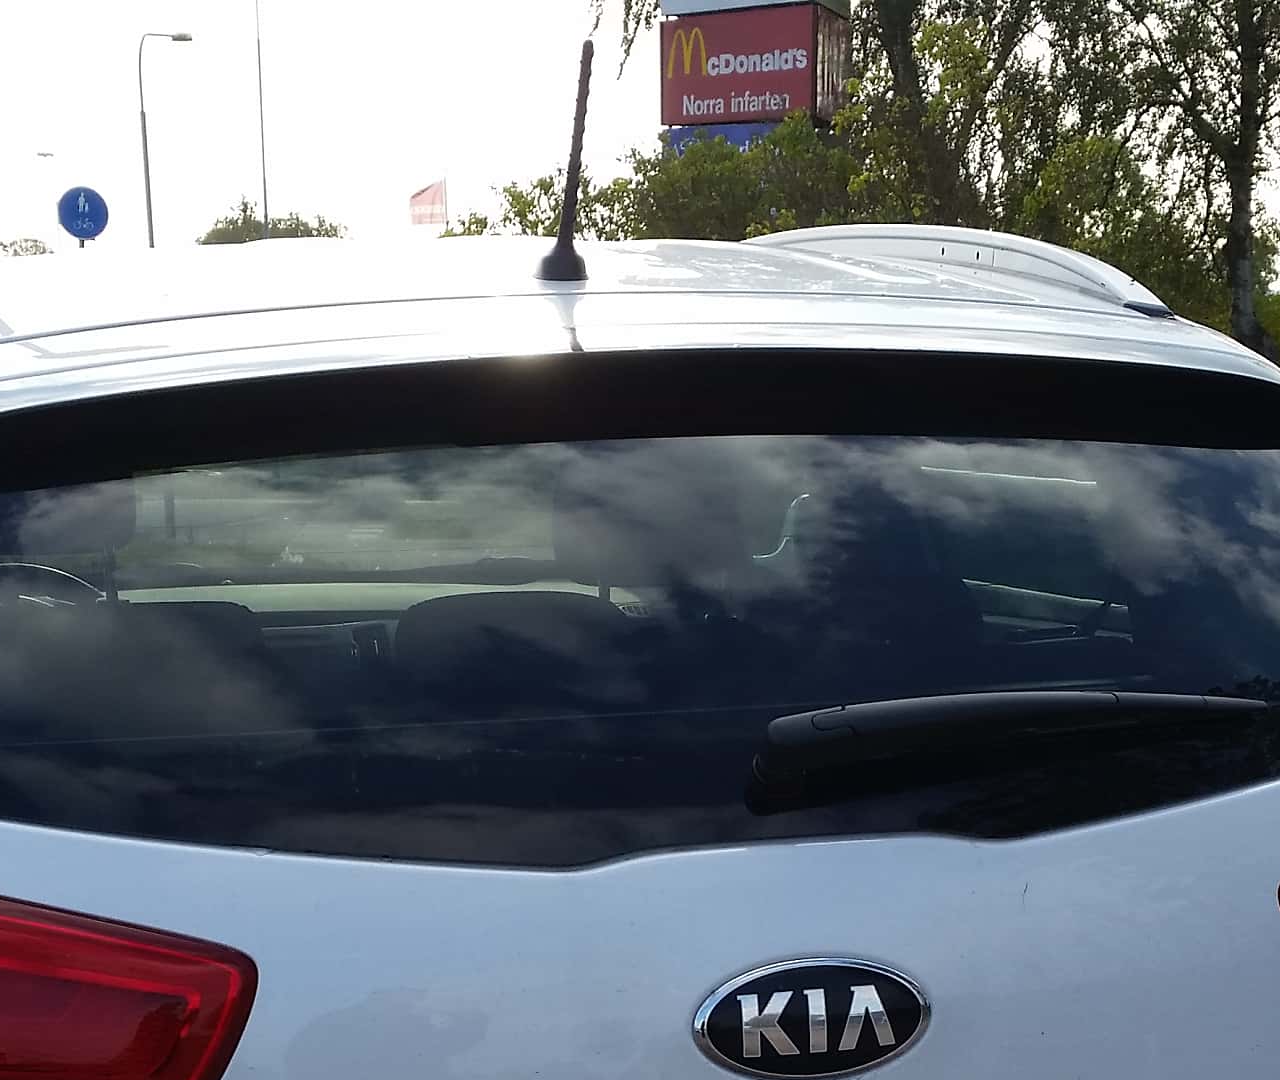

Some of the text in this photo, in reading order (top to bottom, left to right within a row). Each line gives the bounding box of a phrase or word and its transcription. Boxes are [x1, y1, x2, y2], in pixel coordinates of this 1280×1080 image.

[667, 27, 808, 79] McDonald's
[682, 90, 790, 116] Norra infarten
[736, 984, 896, 1058] KIA
